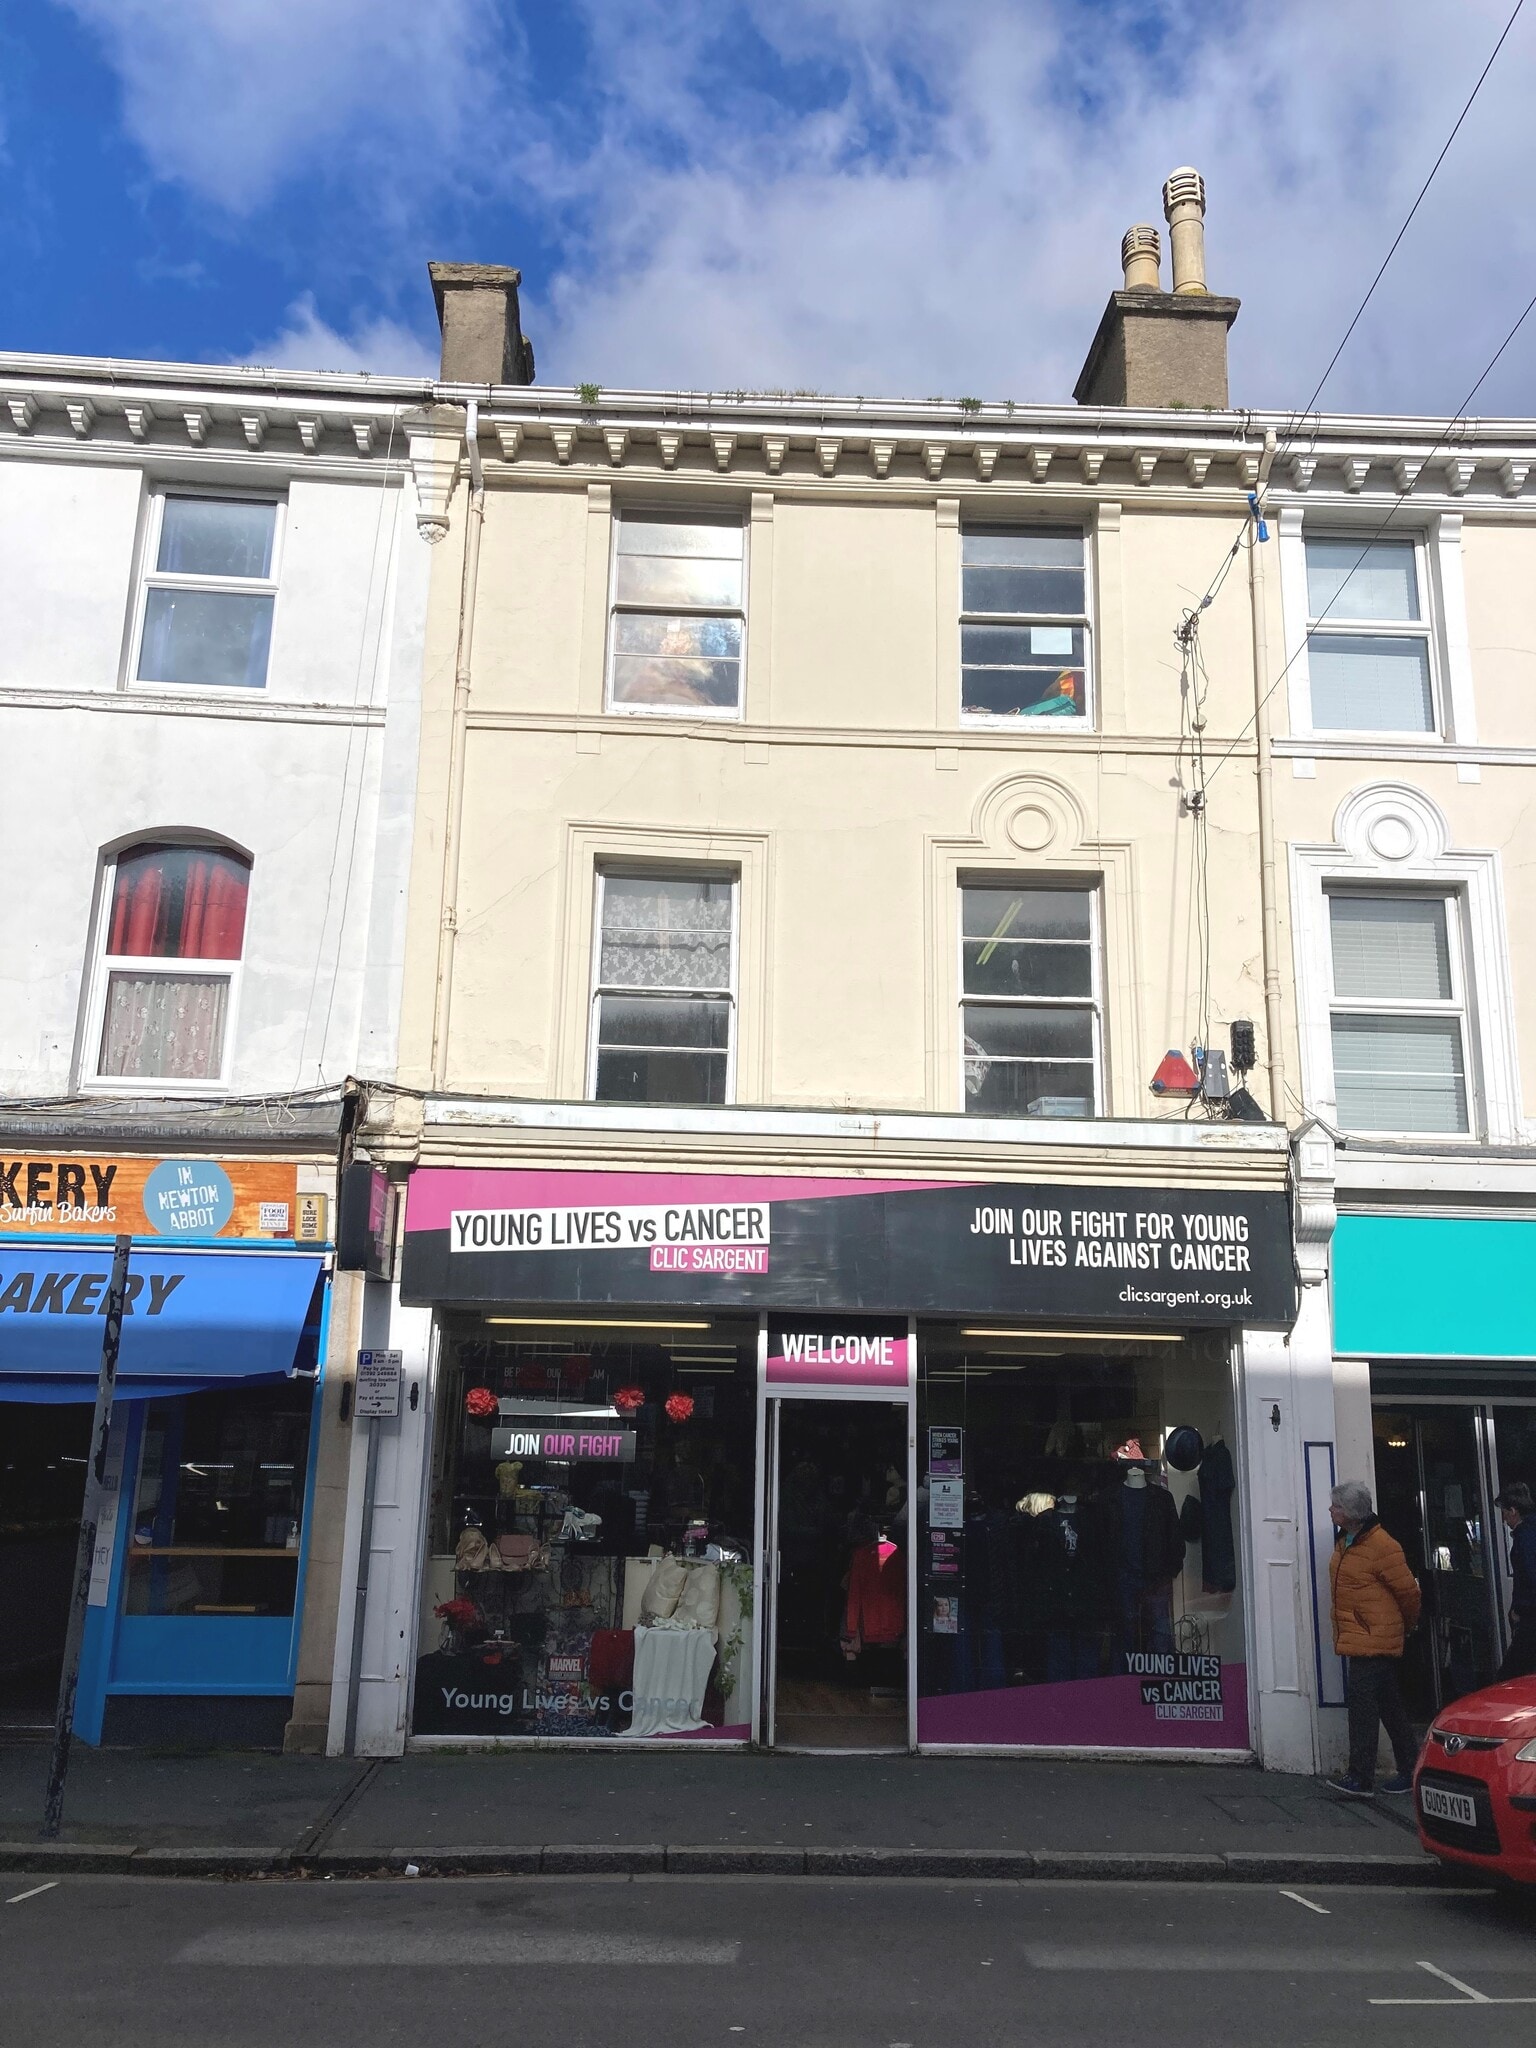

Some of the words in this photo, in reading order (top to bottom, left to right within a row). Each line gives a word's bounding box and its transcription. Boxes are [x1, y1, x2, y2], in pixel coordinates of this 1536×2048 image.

[177, 1166, 194, 1186] IN
[158, 1184, 219, 1210] NEWTON
[0, 1201, 54, 1225] Surfin
[57, 1201, 117, 1223] Bakers
[170, 1206, 215, 1231] ABBOT
[970, 1207, 1014, 1234] JOIN
[1022, 1208, 1063, 1236] OUR
[1070, 1210, 1128, 1238] FIGHT
[1135, 1212, 1175, 1240] FOR
[1181, 1214, 1249, 1242] YOUNG
[455, 1213, 543, 1247] YOUNG
[551, 1211, 622, 1244] LIVES
[628, 1219, 657, 1243] vs
[664, 1208, 765, 1241] CANCER
[652, 1247, 688, 1268] CLIC
[692, 1248, 766, 1270] SARGENT
[1010, 1238, 1067, 1267] LIVES
[1075, 1240, 1162, 1270] AGAINST
[1170, 1243, 1251, 1272] CANCER
[0, 1273, 186, 1316] AKERY
[1119, 1284, 1253, 1310] clicsargent.org.uk
[781, 1333, 894, 1366] WELCOME
[504, 1433, 540, 1455] JOIN
[544, 1434, 575, 1456] OUR
[579, 1435, 622, 1456] FIGHT
[94, 1546, 111, 1565] HEY
[550, 1657, 582, 1671] MARVEL
[1125, 1652, 1175, 1675] YOUNG
[1179, 1655, 1219, 1677] LIVES
[441, 1687, 513, 1715] Young
[522, 1688, 578, 1711] Lives
[586, 1695, 610, 1711] vs
[1143, 1687, 1160, 1702] vs
[1163, 1680, 1222, 1702] CANCER
[1157, 1705, 1177, 1718] CLIC
[1180, 1705, 1222, 1719] SARGENT
[1425, 1790, 1448, 1816] GU09
[1448, 1795, 1471, 1821] KVB
